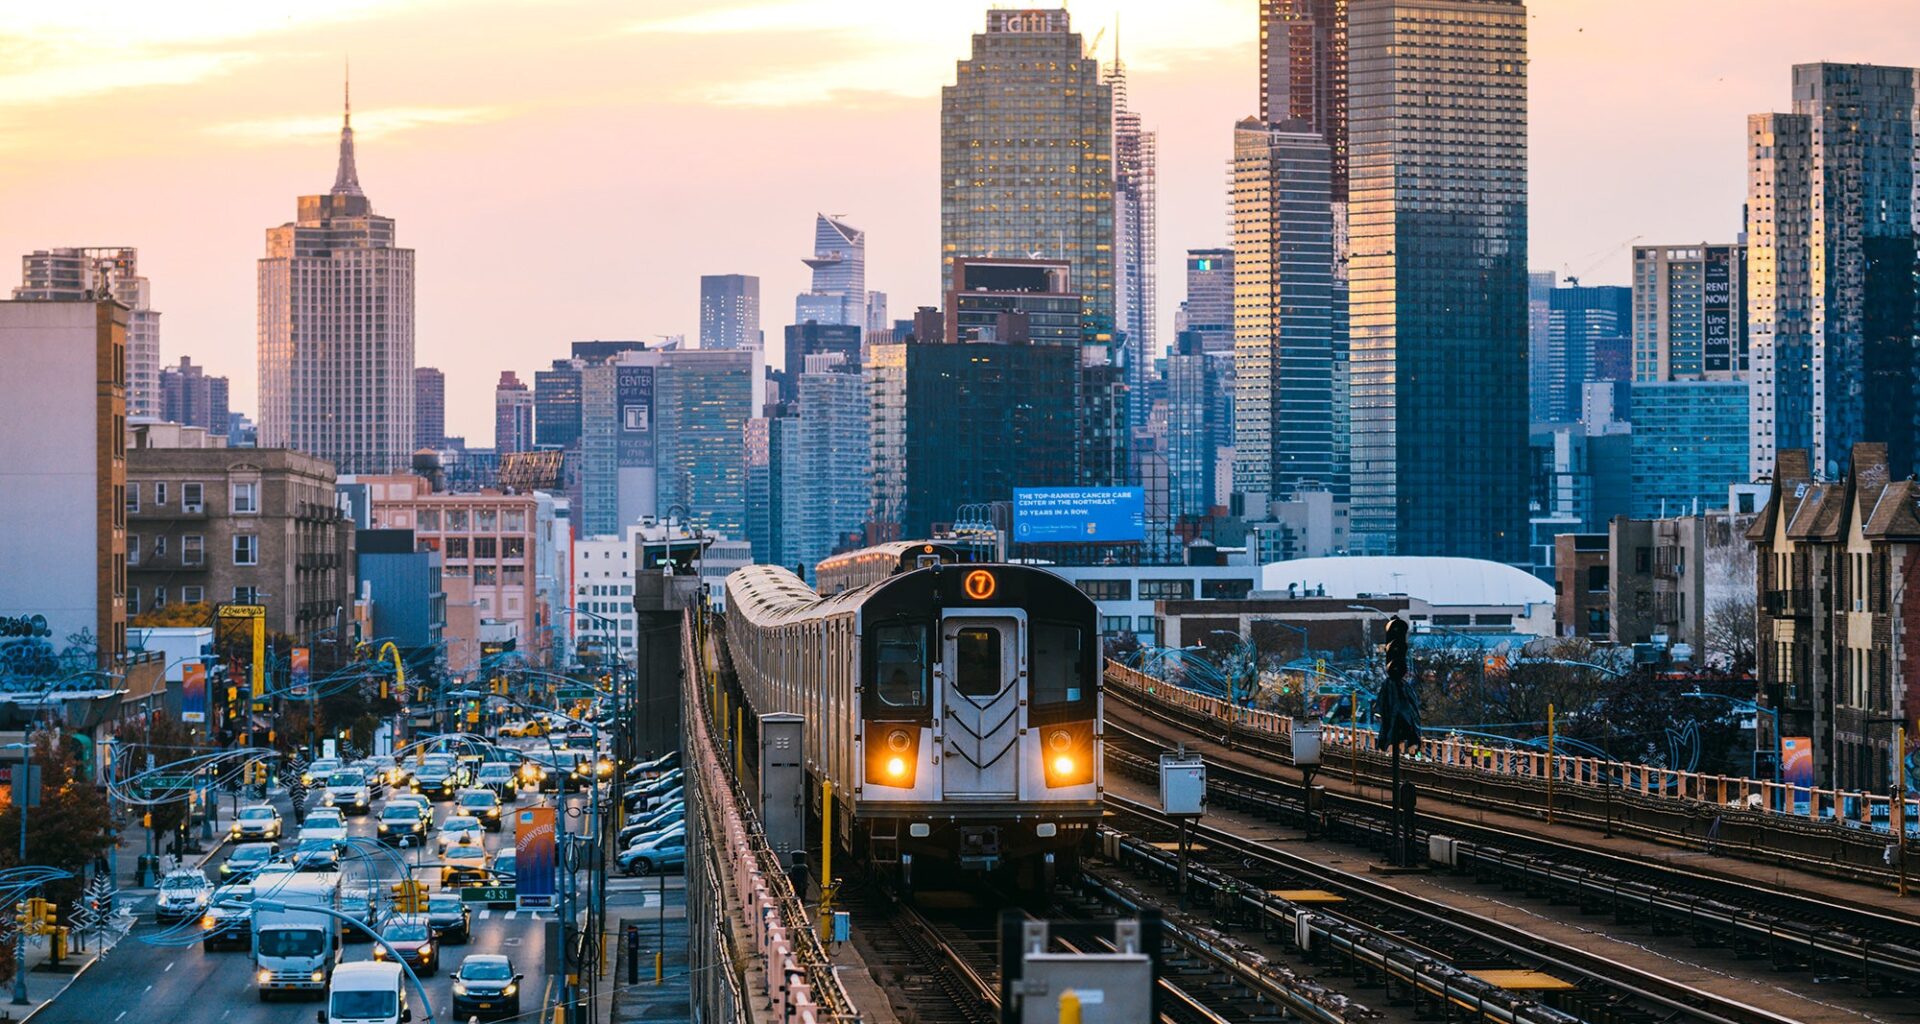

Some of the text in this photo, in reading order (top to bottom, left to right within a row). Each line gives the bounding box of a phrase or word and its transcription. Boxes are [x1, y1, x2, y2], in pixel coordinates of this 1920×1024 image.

[1007, 13, 1046, 32] citi
[1705, 282, 1729, 292] RENT
[1705, 295, 1729, 304] NOW
[1707, 315, 1727, 325] Linc
[1709, 325, 1725, 335] LIC
[1706, 336, 1730, 346] .com
[619, 375, 652, 387] CENTER
[619, 387, 652, 396] OF IT ALL
[516, 824, 554, 852] SUNNYSIDE
[485, 890, 508, 899] 43 St
